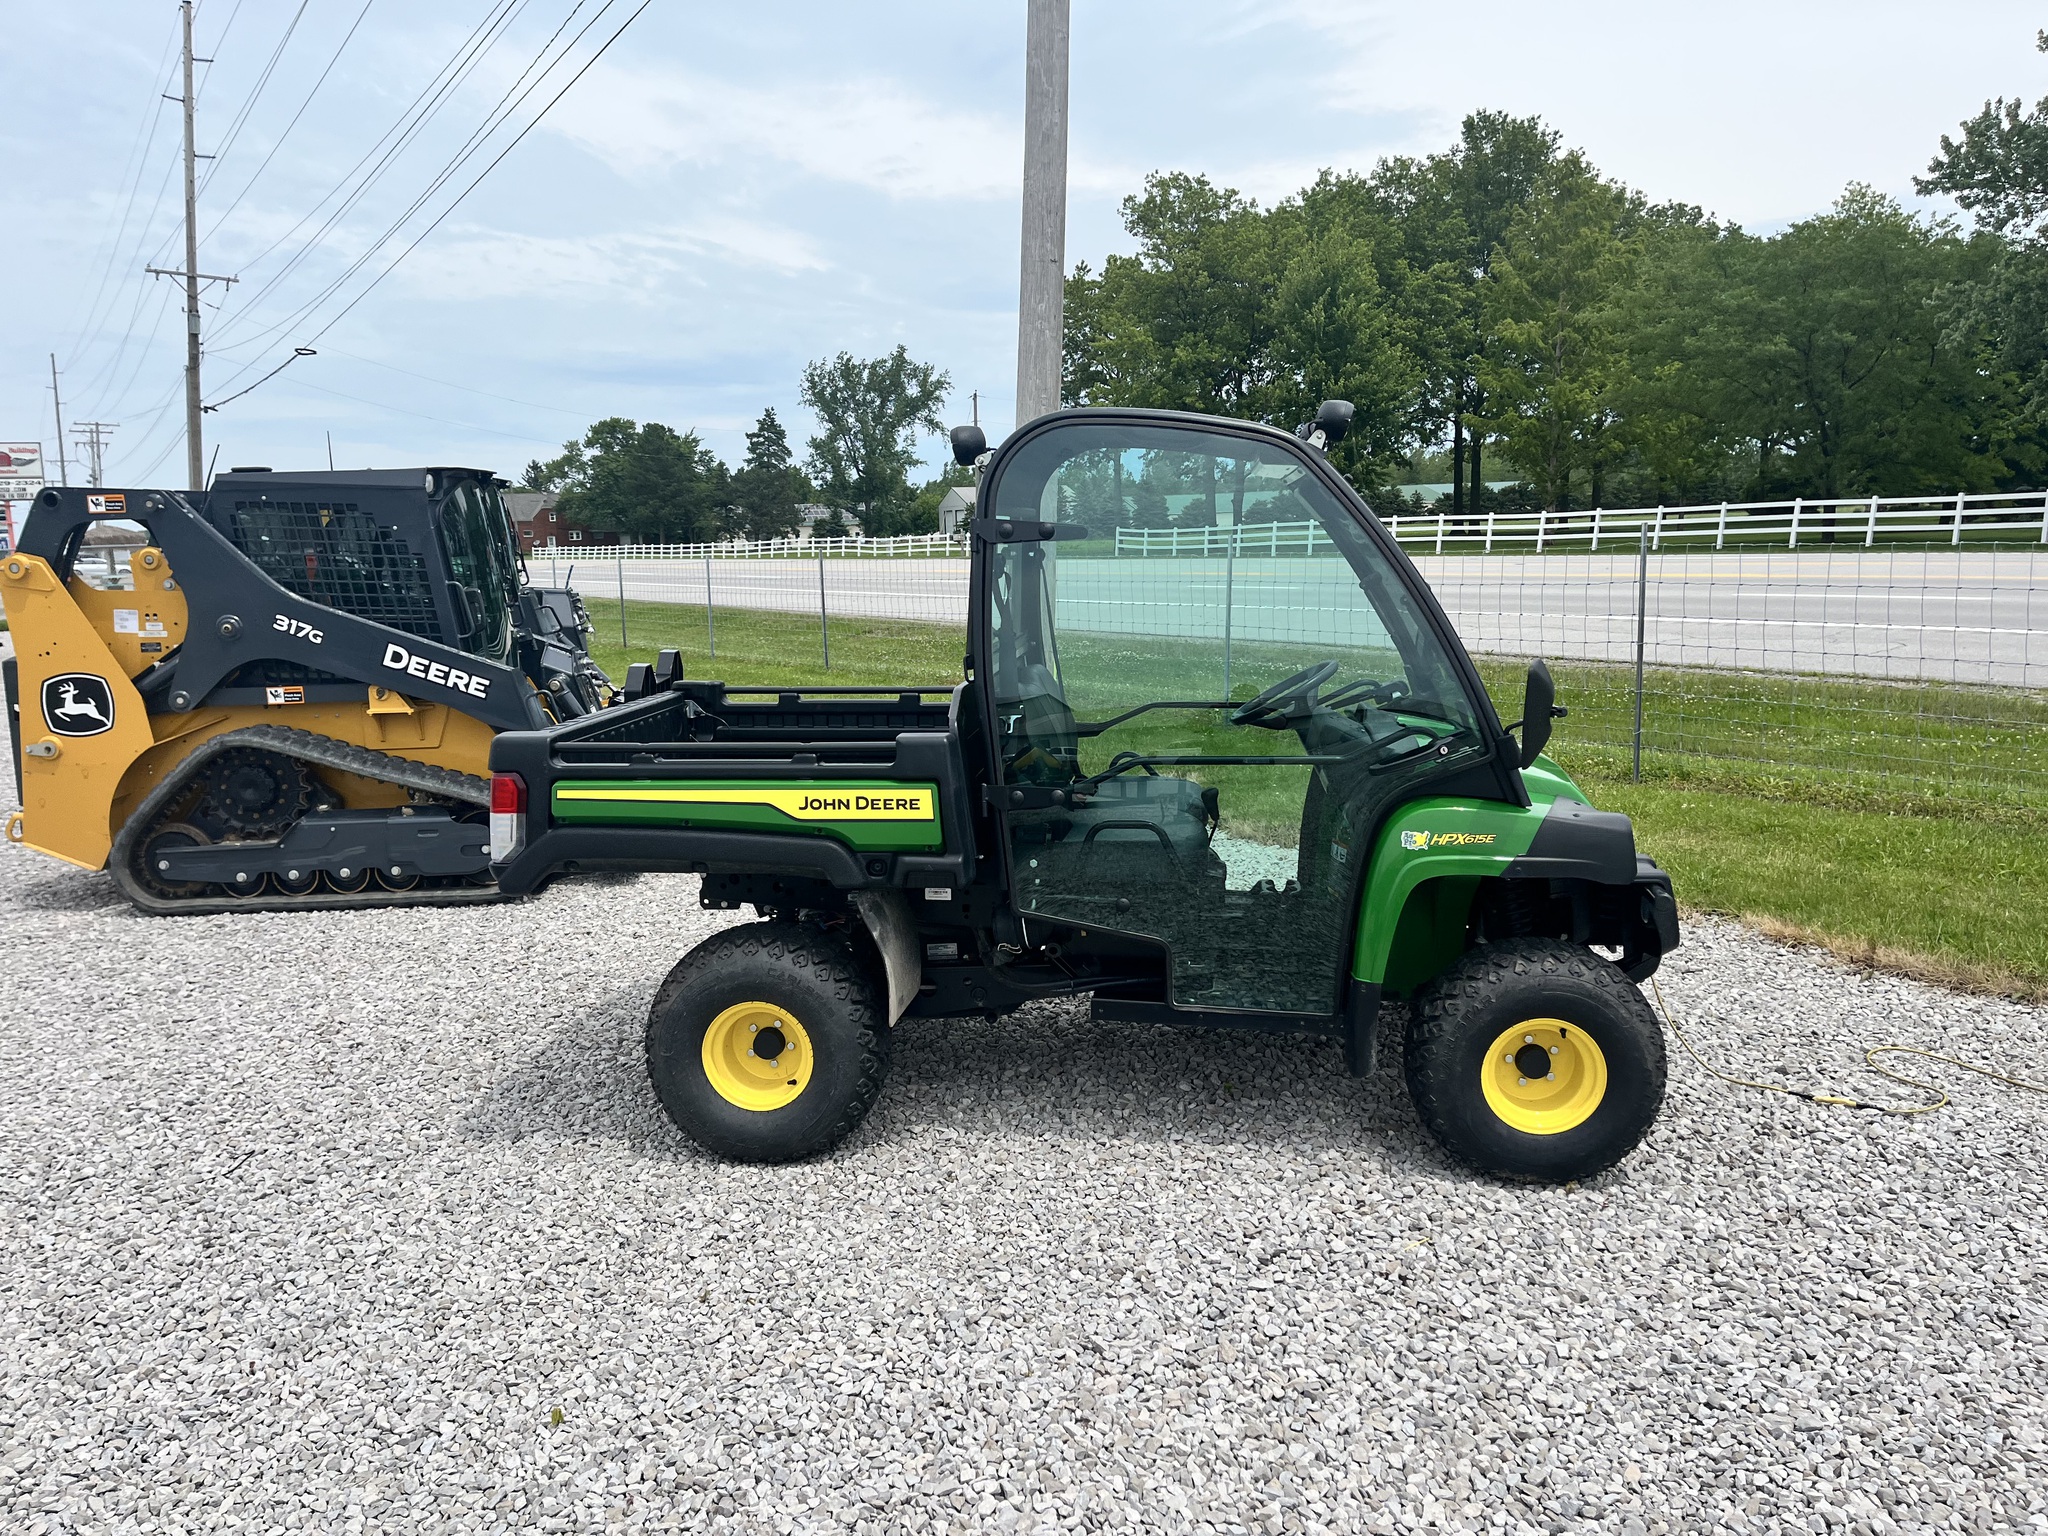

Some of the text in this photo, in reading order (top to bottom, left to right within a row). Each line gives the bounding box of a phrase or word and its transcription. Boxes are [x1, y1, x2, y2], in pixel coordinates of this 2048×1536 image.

[272, 614, 324, 644] 317G
[382, 643, 490, 699] DEERE
[798, 795, 921, 811] JOHN DEERE
